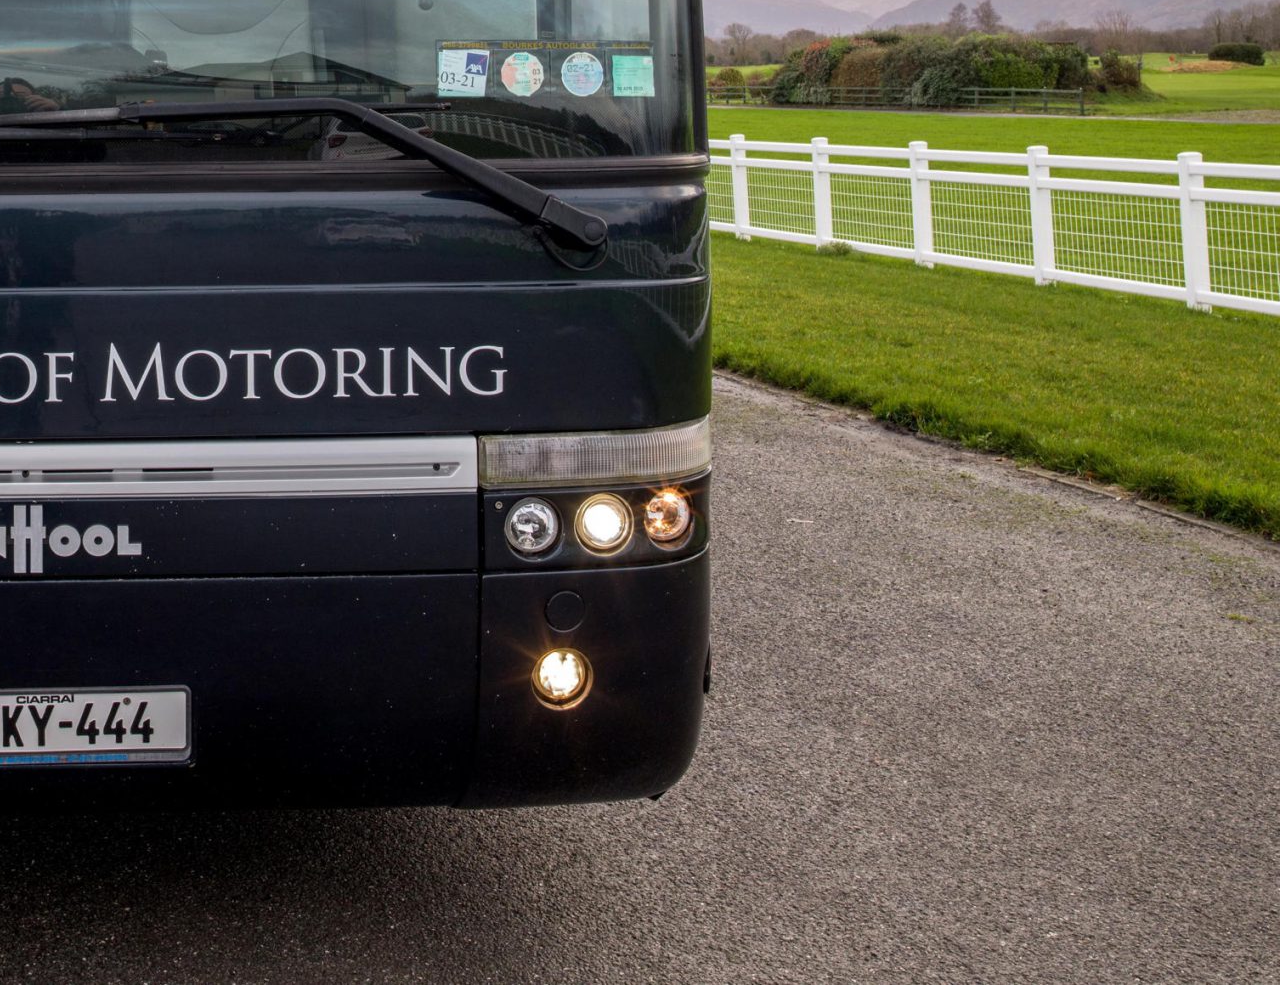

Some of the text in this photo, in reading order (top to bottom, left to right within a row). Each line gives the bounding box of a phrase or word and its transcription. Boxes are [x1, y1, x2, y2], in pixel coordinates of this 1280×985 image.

[465, 64, 483, 74] AXA
[440, 71, 475, 88] 03-21
[100, 342, 508, 402] MOTORING
